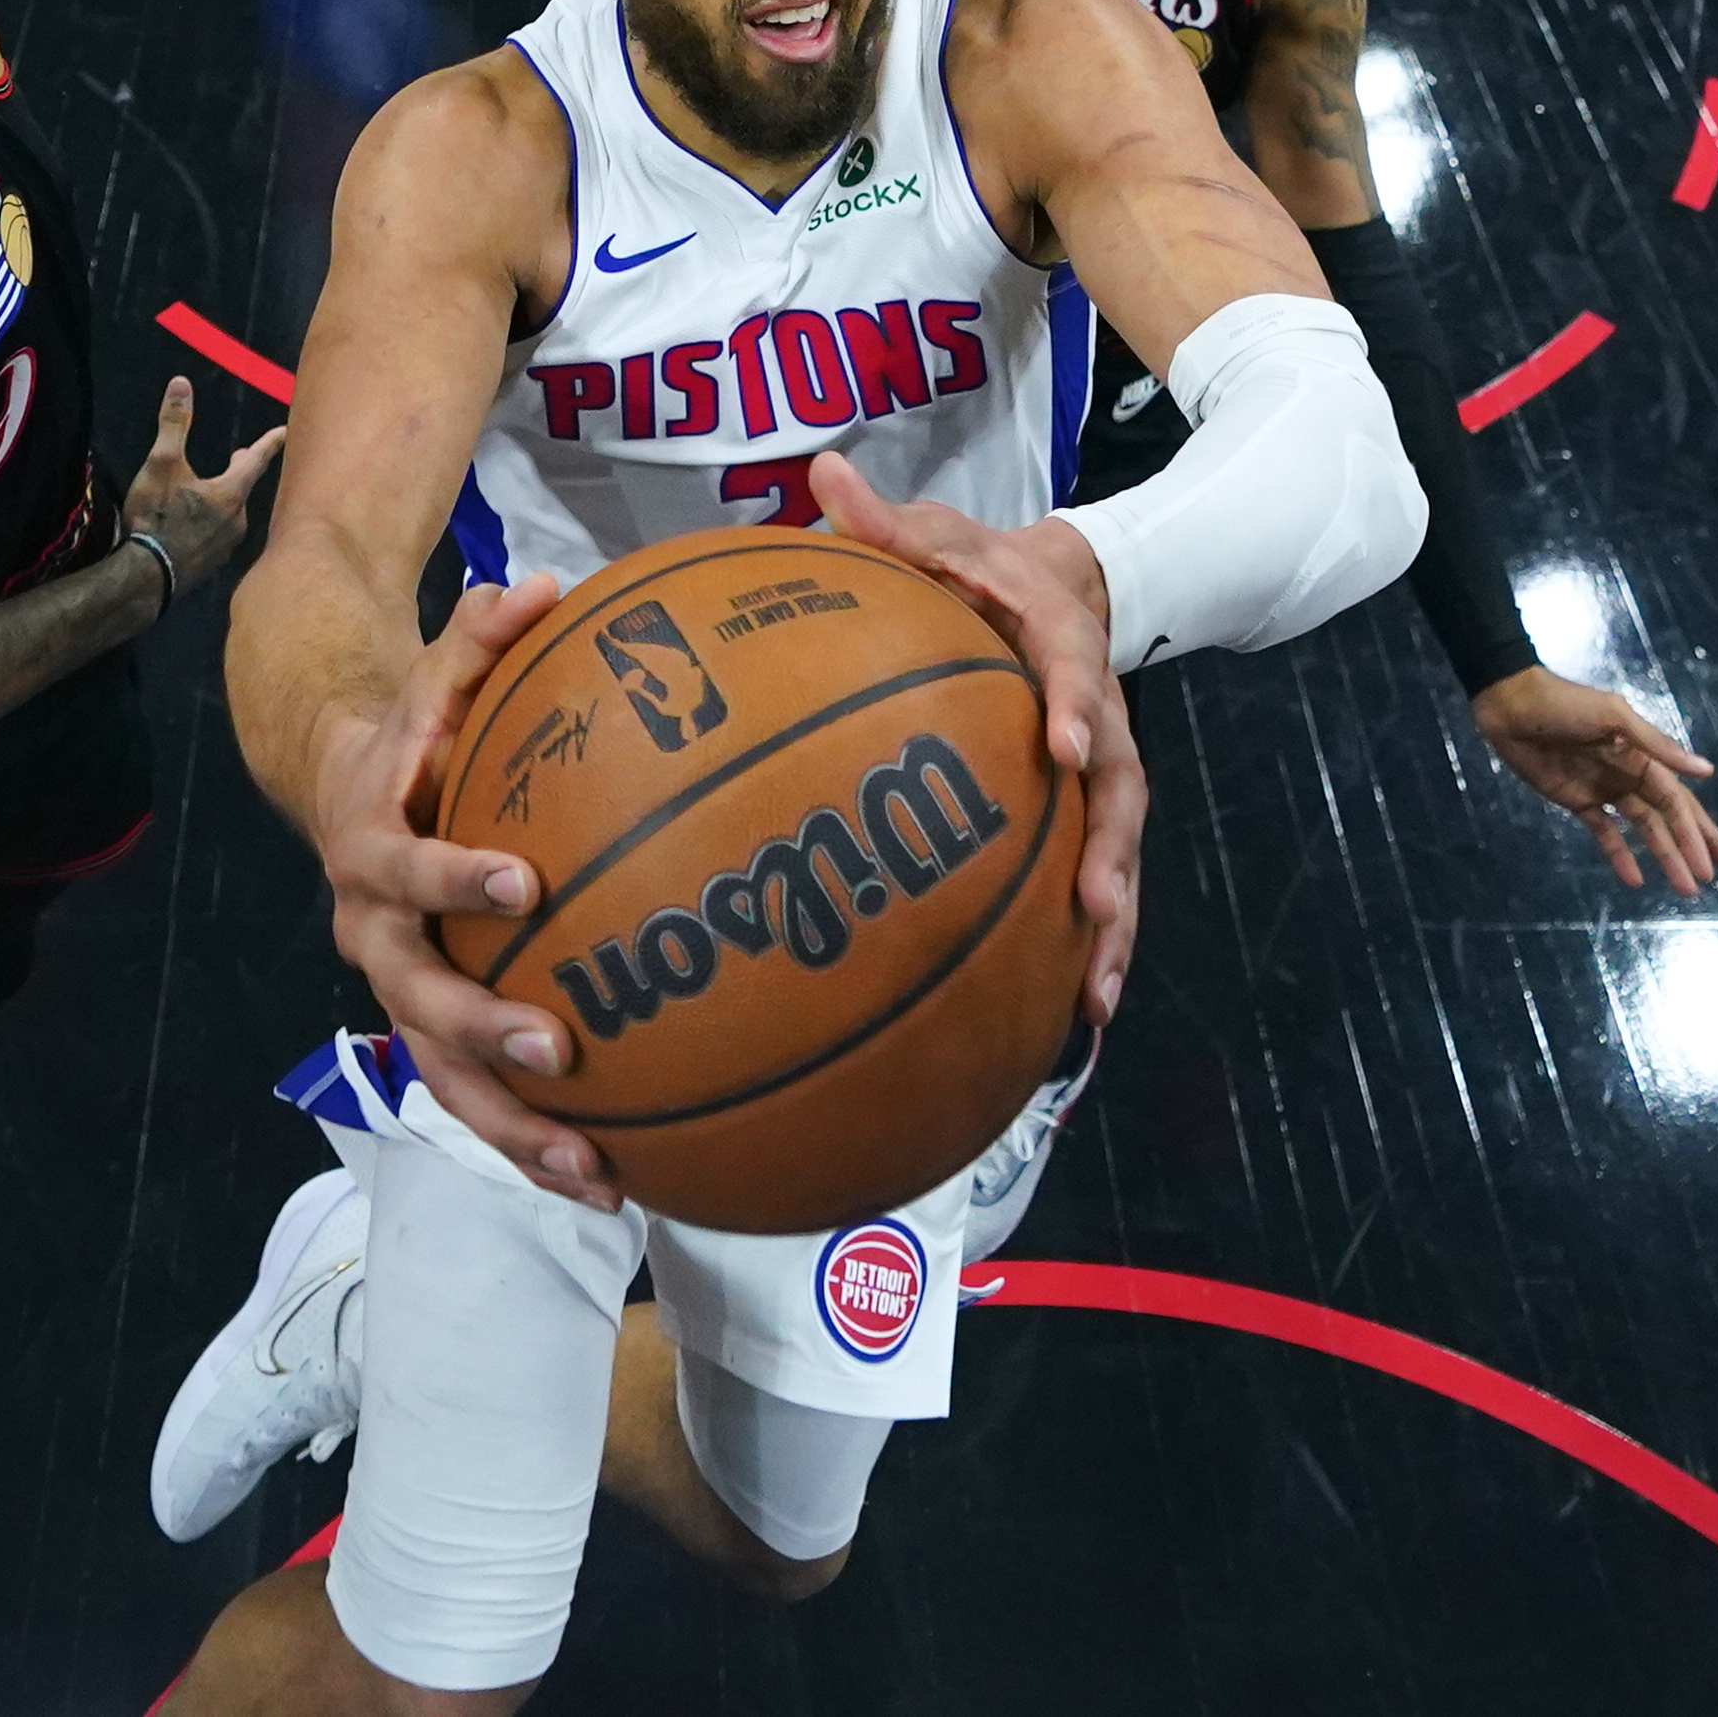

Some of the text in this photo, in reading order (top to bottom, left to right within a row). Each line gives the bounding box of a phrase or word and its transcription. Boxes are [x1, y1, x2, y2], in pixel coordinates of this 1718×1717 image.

[526, 299, 988, 441] PISTONS
[552, 733, 1008, 1042] Wilson
[840, 1279, 908, 1319] PISTONS
[843, 1257, 912, 1295] DETROIT
